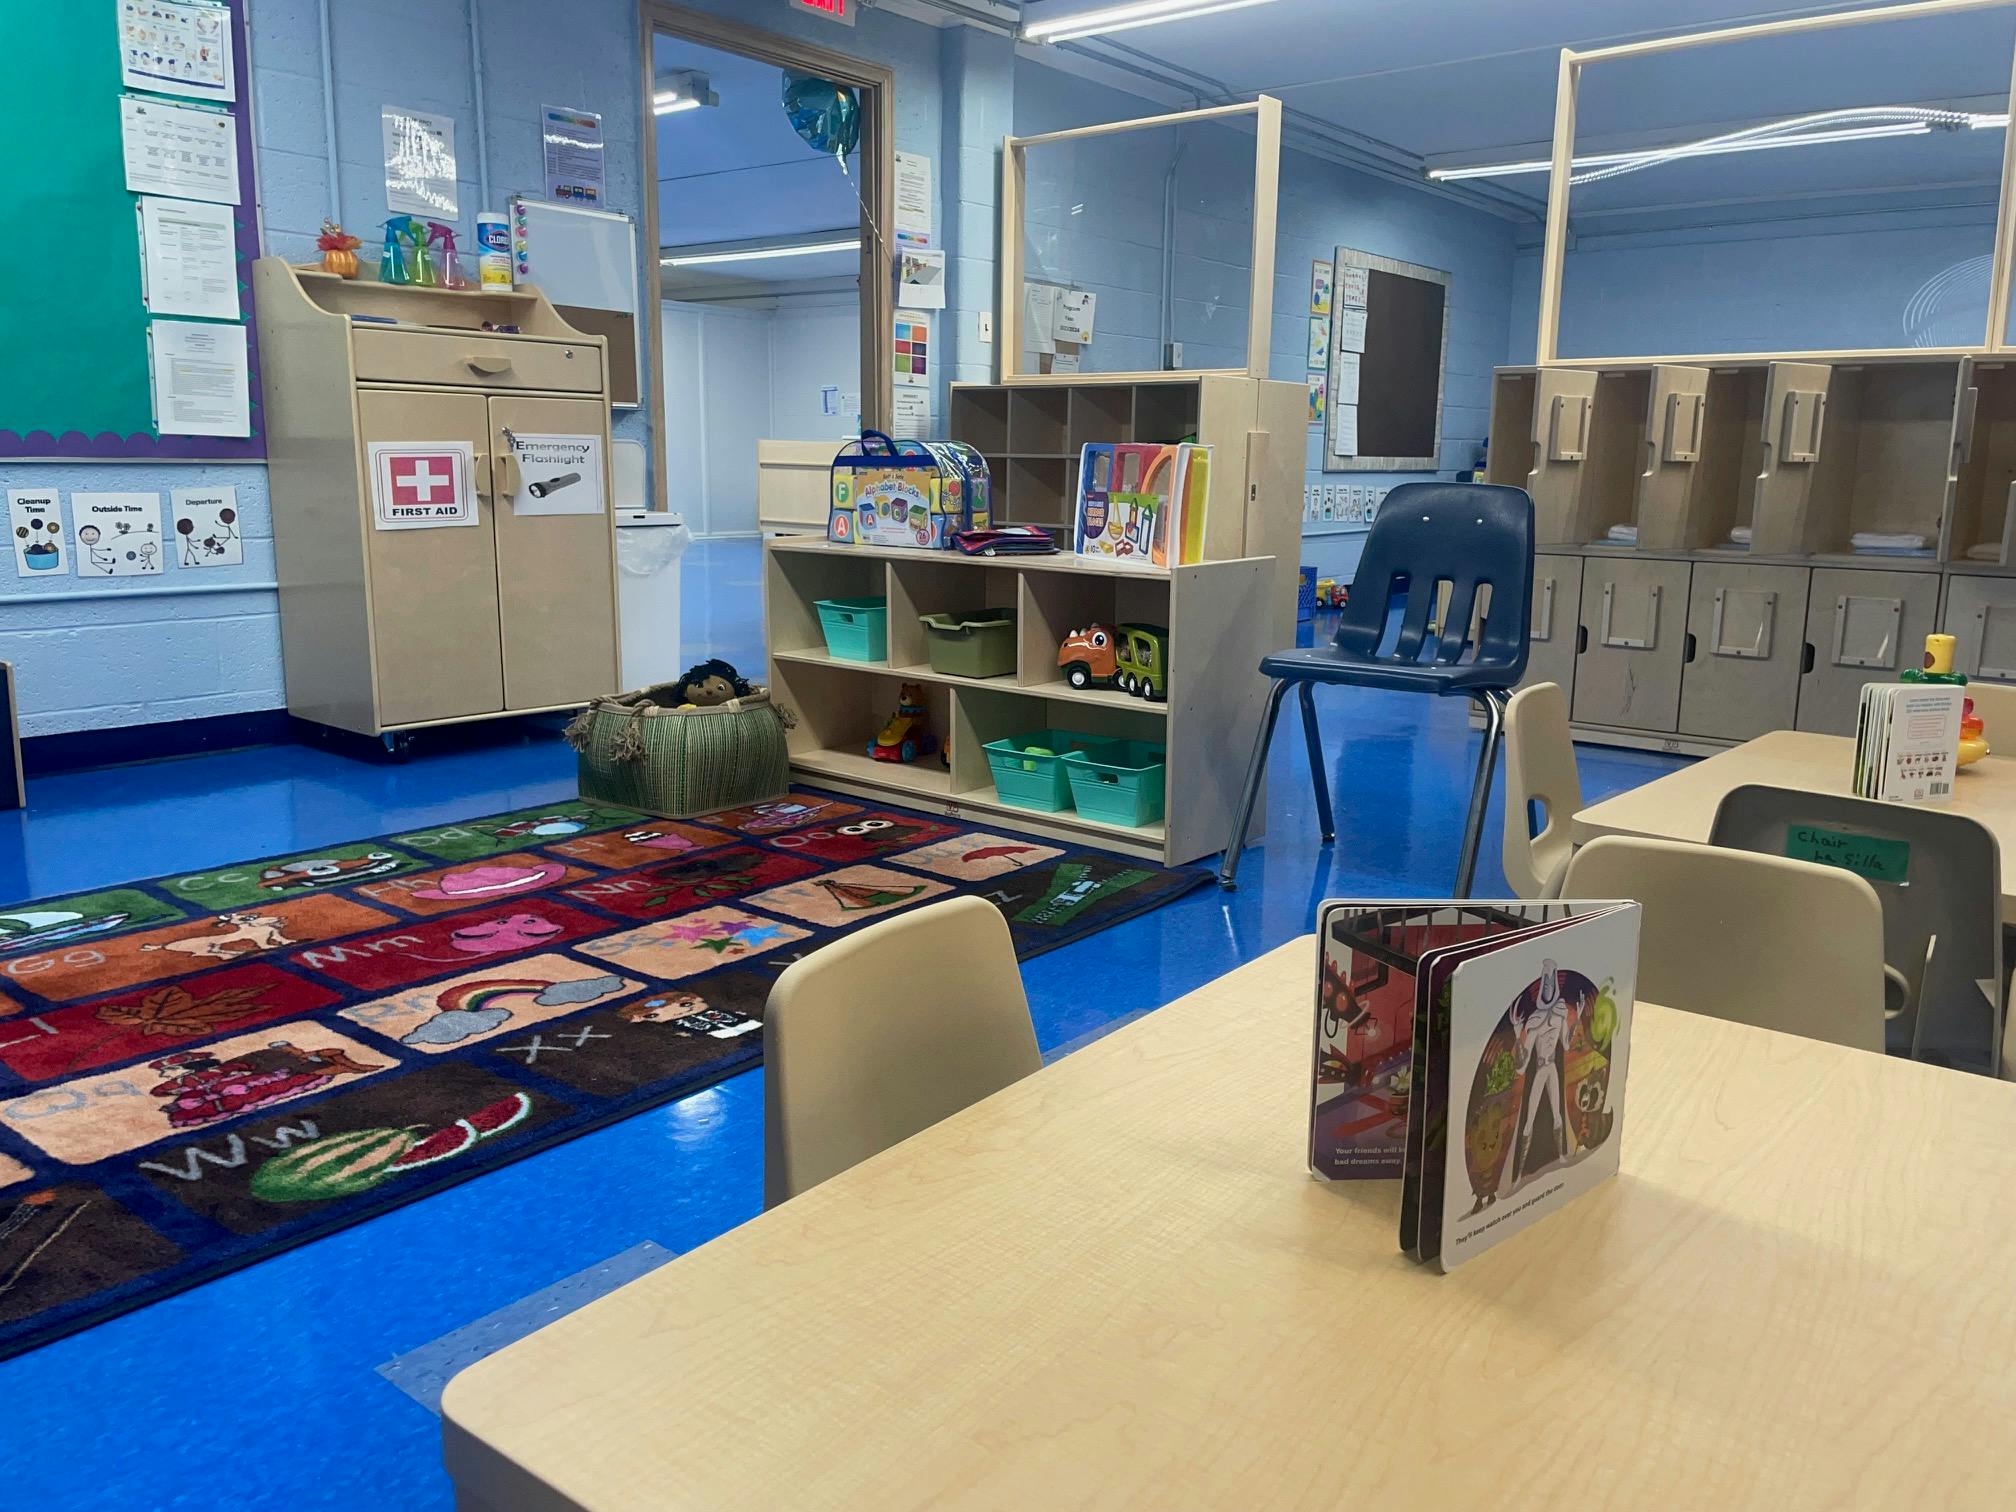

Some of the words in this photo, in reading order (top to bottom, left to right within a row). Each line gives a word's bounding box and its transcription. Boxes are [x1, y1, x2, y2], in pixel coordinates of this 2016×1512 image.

[488, 235, 510, 246] CLOR
[515, 440, 590, 453] Emergency
[522, 453, 586, 465] Flashlight
[838, 483, 846, 500] F
[864, 481, 896, 497] Alphabet
[897, 481, 921, 498] Blocks
[16, 497, 51, 507] Cleanup
[25, 505, 46, 513] Time
[91, 505, 123, 513] Outside
[124, 505, 143, 513] Time
[185, 498, 223, 506] Departure
[392, 507, 432, 516] FIRST
[435, 506, 458, 515] AID
[837, 516, 846, 534] A
[918, 531, 927, 539] 26
[178, 872, 250, 892] Cc
[568, 878, 650, 901] Nn
[301, 932, 426, 969] Mm
[7, 950, 106, 974] Gg
[138, 1120, 320, 1181] Ww
[1335, 1147, 1352, 1155] Your
[1354, 1146, 1381, 1154] friends
[1455, 1231, 1473, 1246] They'll
[1473, 1225, 1486, 1236] keep
[1485, 1216, 1501, 1229] watch
[1501, 1211, 1512, 1221] over
[1512, 1206, 1522, 1216] you
[1522, 1200, 1531, 1210] and
[1531, 1193, 1545, 1206] guard
[1545, 1188, 1553, 1197] the
